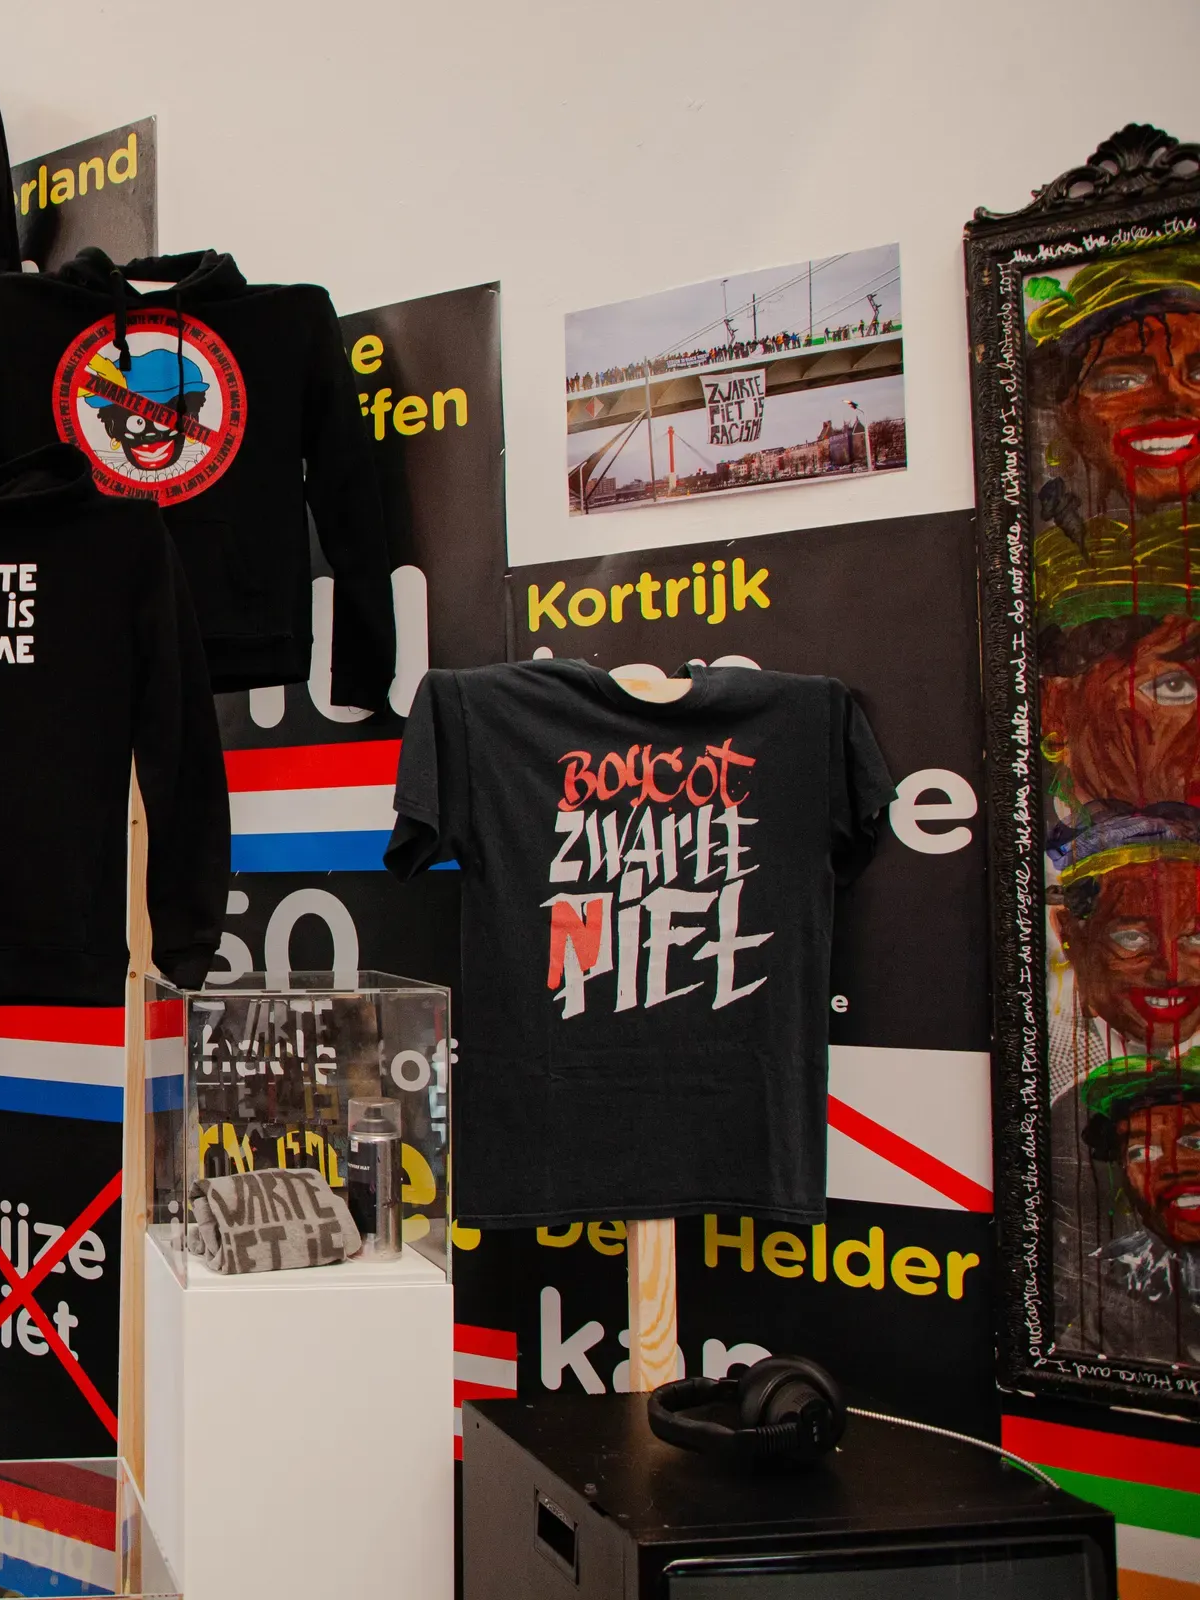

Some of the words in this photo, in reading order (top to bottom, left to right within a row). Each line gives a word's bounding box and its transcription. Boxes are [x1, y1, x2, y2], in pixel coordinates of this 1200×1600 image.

[13, 132, 138, 216] rland
[86, 375, 143, 416] ZWARTE
[143, 398, 175, 429] PIET
[704, 376, 764, 404] ZWARTE
[528, 557, 771, 632] Kortrijk
[1007, 567, 1023, 594] not
[1007, 599, 1025, 624] do
[1010, 651, 1027, 693] and
[704, 1213, 980, 1300] Helder
